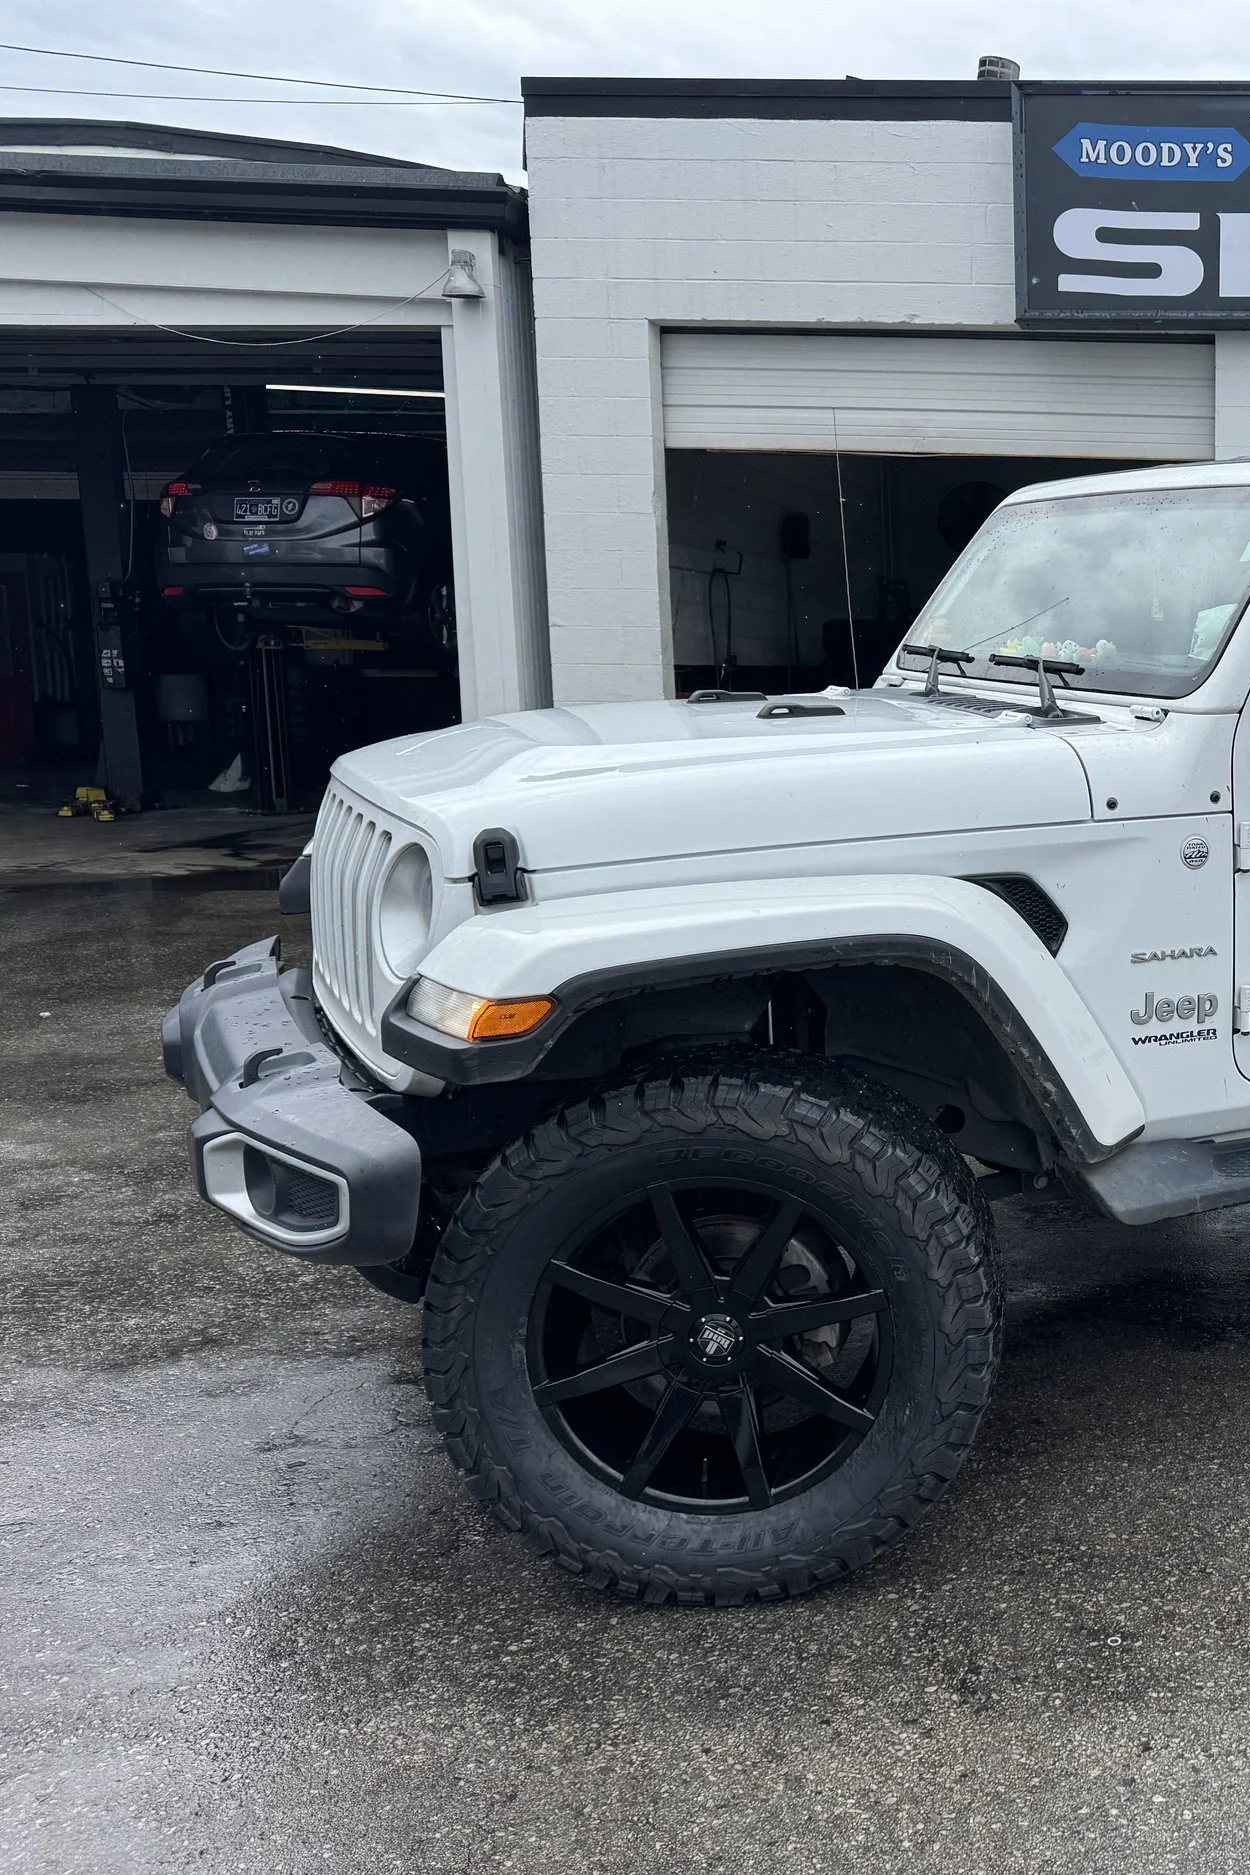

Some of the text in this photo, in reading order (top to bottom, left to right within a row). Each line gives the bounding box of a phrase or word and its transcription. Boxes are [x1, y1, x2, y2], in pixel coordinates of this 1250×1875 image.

[1079, 137, 1233, 169] MOODY'S
[236, 503, 250, 515] 421
[1130, 945, 1218, 964] SAHARA
[1130, 991, 1219, 1025] Jeep
[1131, 1028, 1217, 1046] WRANGLER
[1159, 1035, 1218, 1047] UNLIMITED
